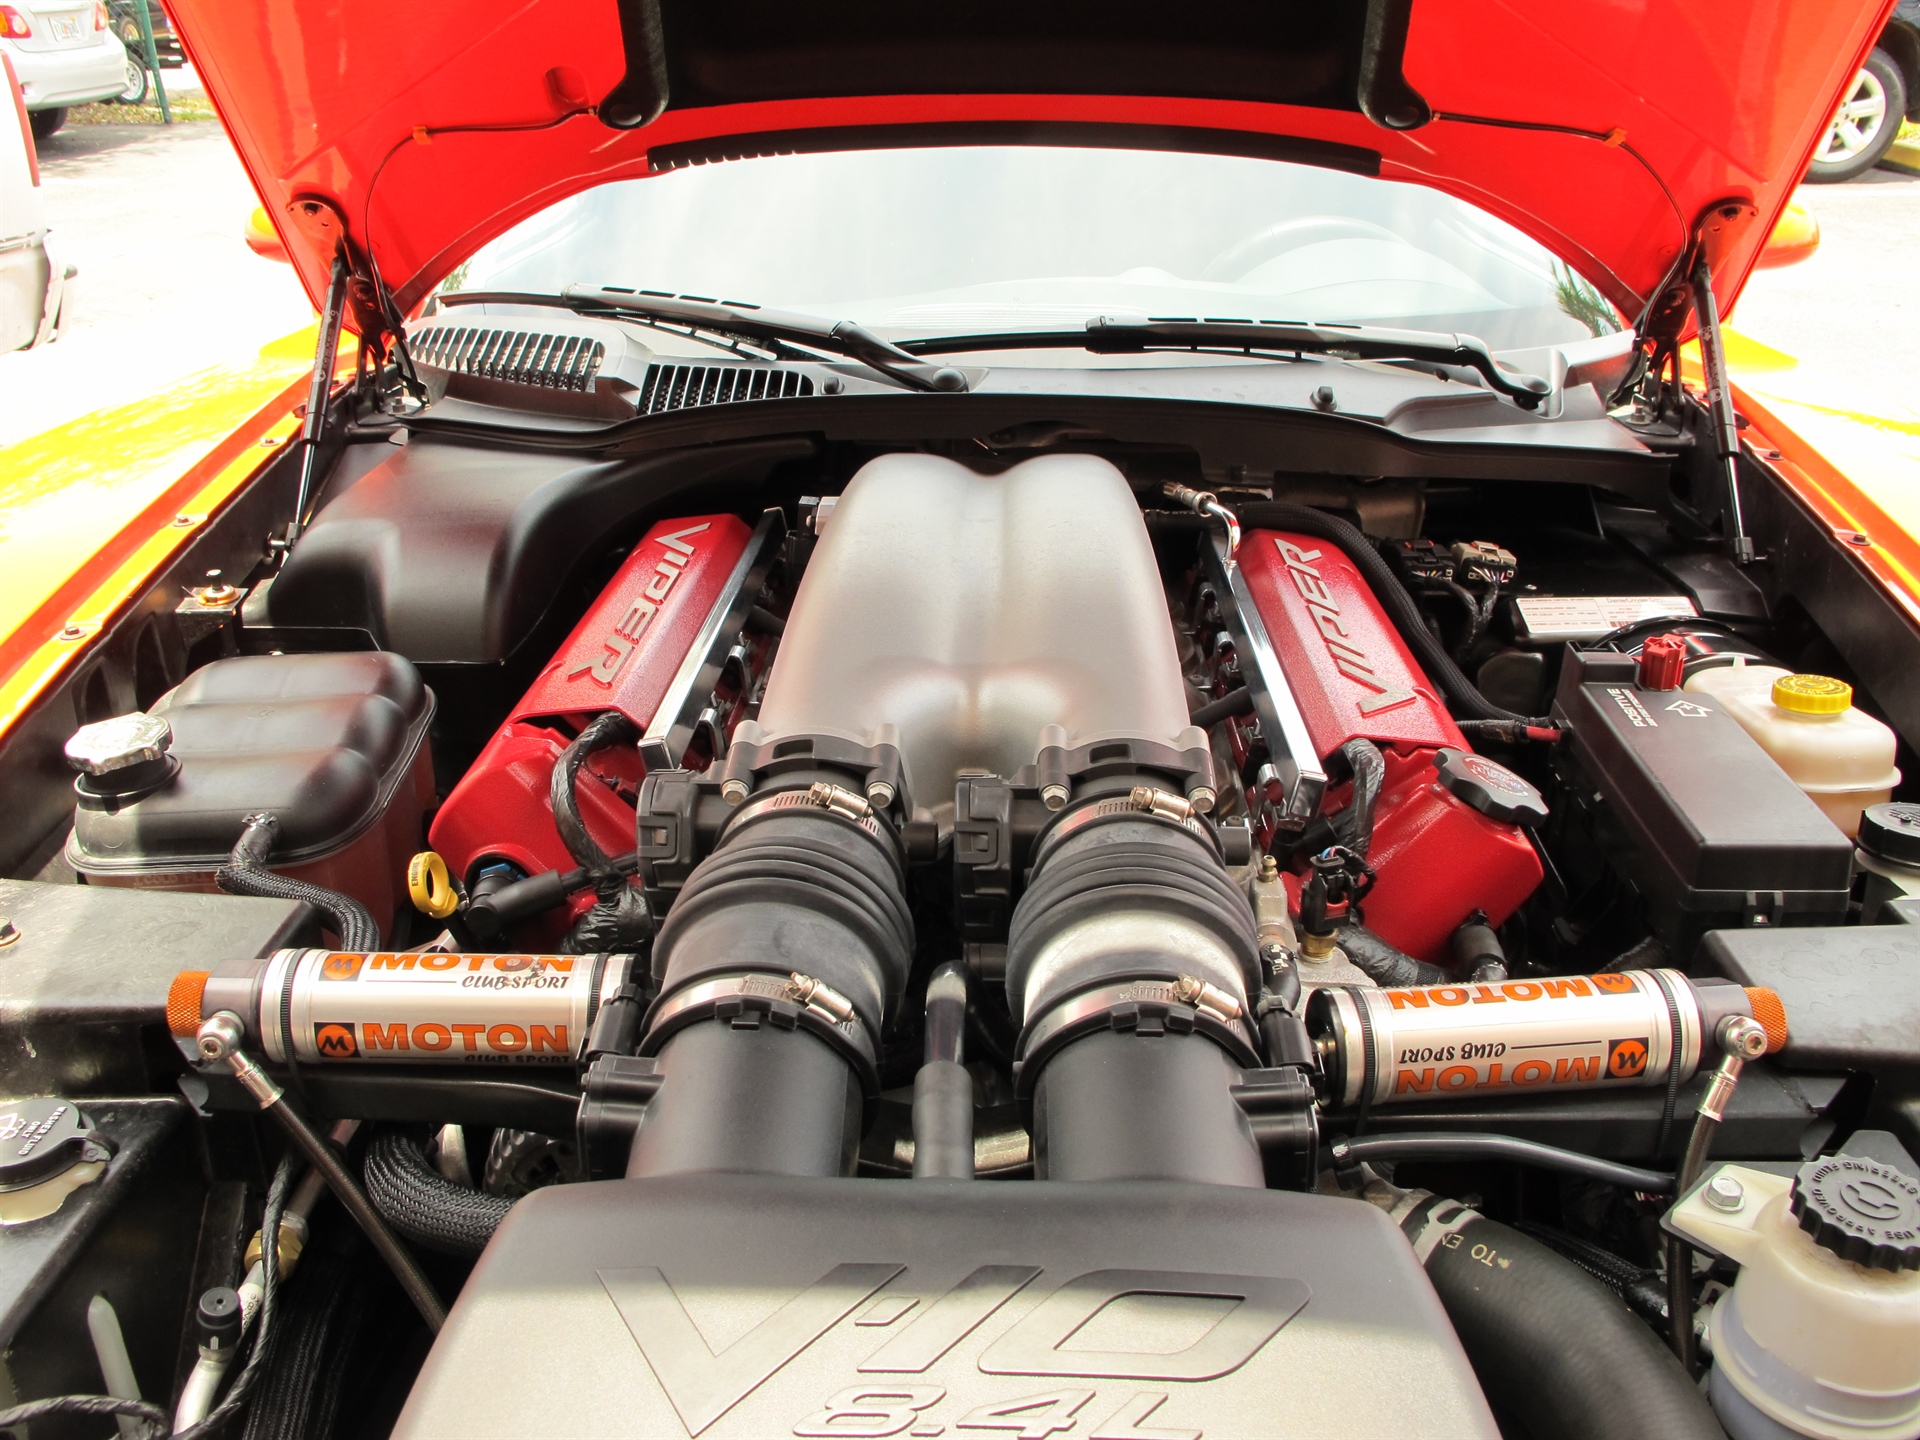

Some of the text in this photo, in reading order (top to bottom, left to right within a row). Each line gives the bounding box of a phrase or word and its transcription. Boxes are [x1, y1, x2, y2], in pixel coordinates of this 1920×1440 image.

[567, 522, 711, 684] VIPER
[1274, 538, 1417, 716] VIPER
[1606, 688, 1648, 727] POSITIVE
[369, 953, 574, 972] MOTON
[461, 975, 570, 989] CLUB SPORT
[1385, 978, 1593, 1010] MOTON
[362, 1022, 570, 1053] MOTON
[1399, 1042, 1506, 1064] CLUB SPORT
[464, 1054, 570, 1065] CLUB SPORT
[1394, 1056, 1601, 1094] MOTON
[18, 1106, 68, 1156] WASHER FLUID
[21, 1120, 42, 1139] ONLY
[1811, 1161, 1918, 1194] STEERING FLUID
[1811, 1187, 1915, 1240] USE APPROVED
[1470, 1243, 1497, 1267] TO
[596, 1262, 1314, 1439] V10
[793, 1384, 1204, 1440] 8.4L
